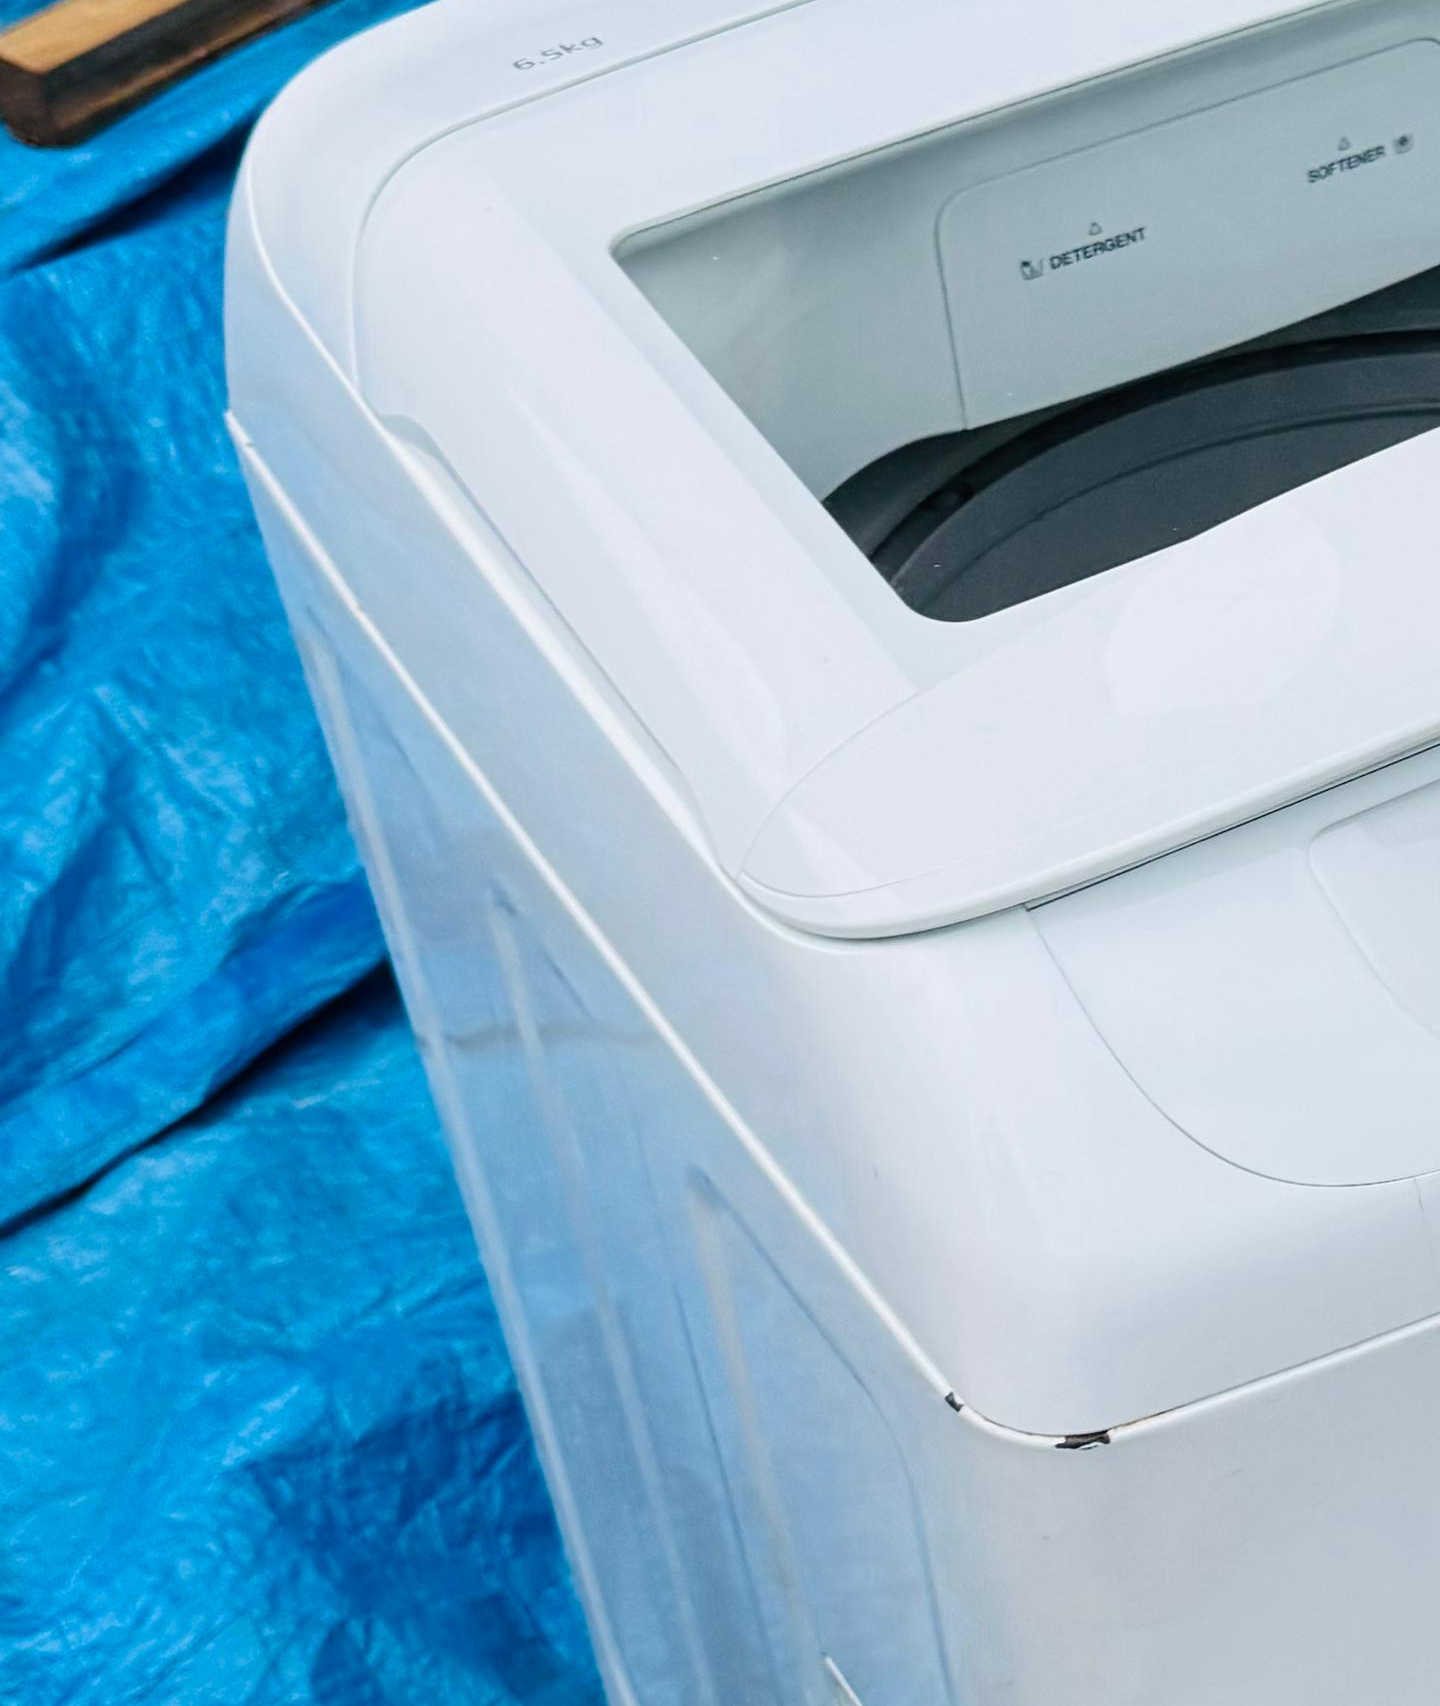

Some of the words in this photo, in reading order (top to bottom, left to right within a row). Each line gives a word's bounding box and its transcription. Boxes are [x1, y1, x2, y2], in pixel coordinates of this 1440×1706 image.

[513, 37, 603, 70] 6.5kg
[1307, 145, 1385, 183] SOFTENER
[1050, 227, 1146, 270] DETERGENT
